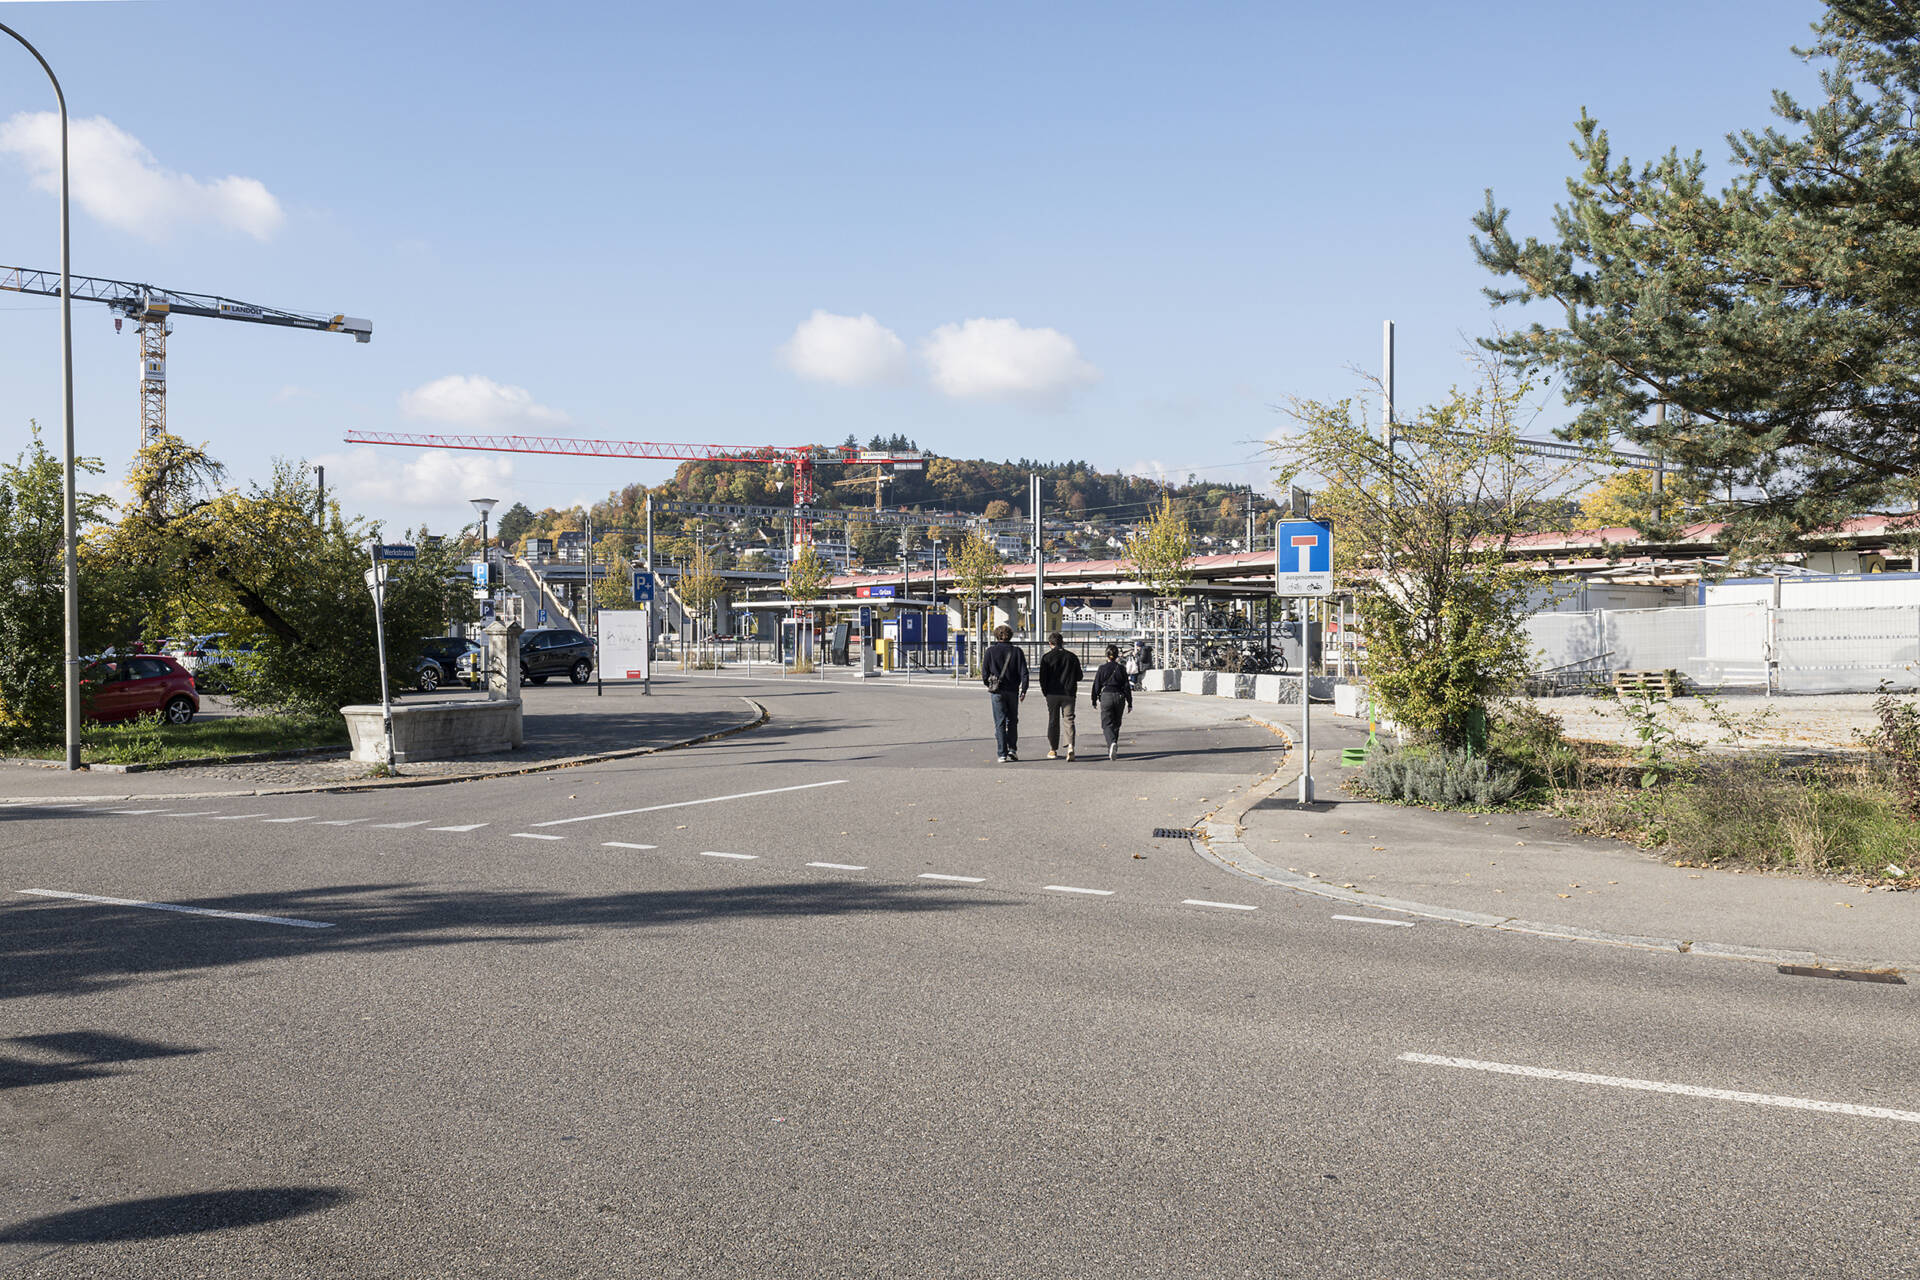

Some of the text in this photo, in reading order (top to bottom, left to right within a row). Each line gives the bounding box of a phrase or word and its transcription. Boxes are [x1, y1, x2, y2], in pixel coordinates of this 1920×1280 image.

[232, 305, 262, 315] LANDOLT
[383, 548, 415, 556] Werkstrasse
[477, 565, 484, 577] P
[484, 606, 490, 615] P
